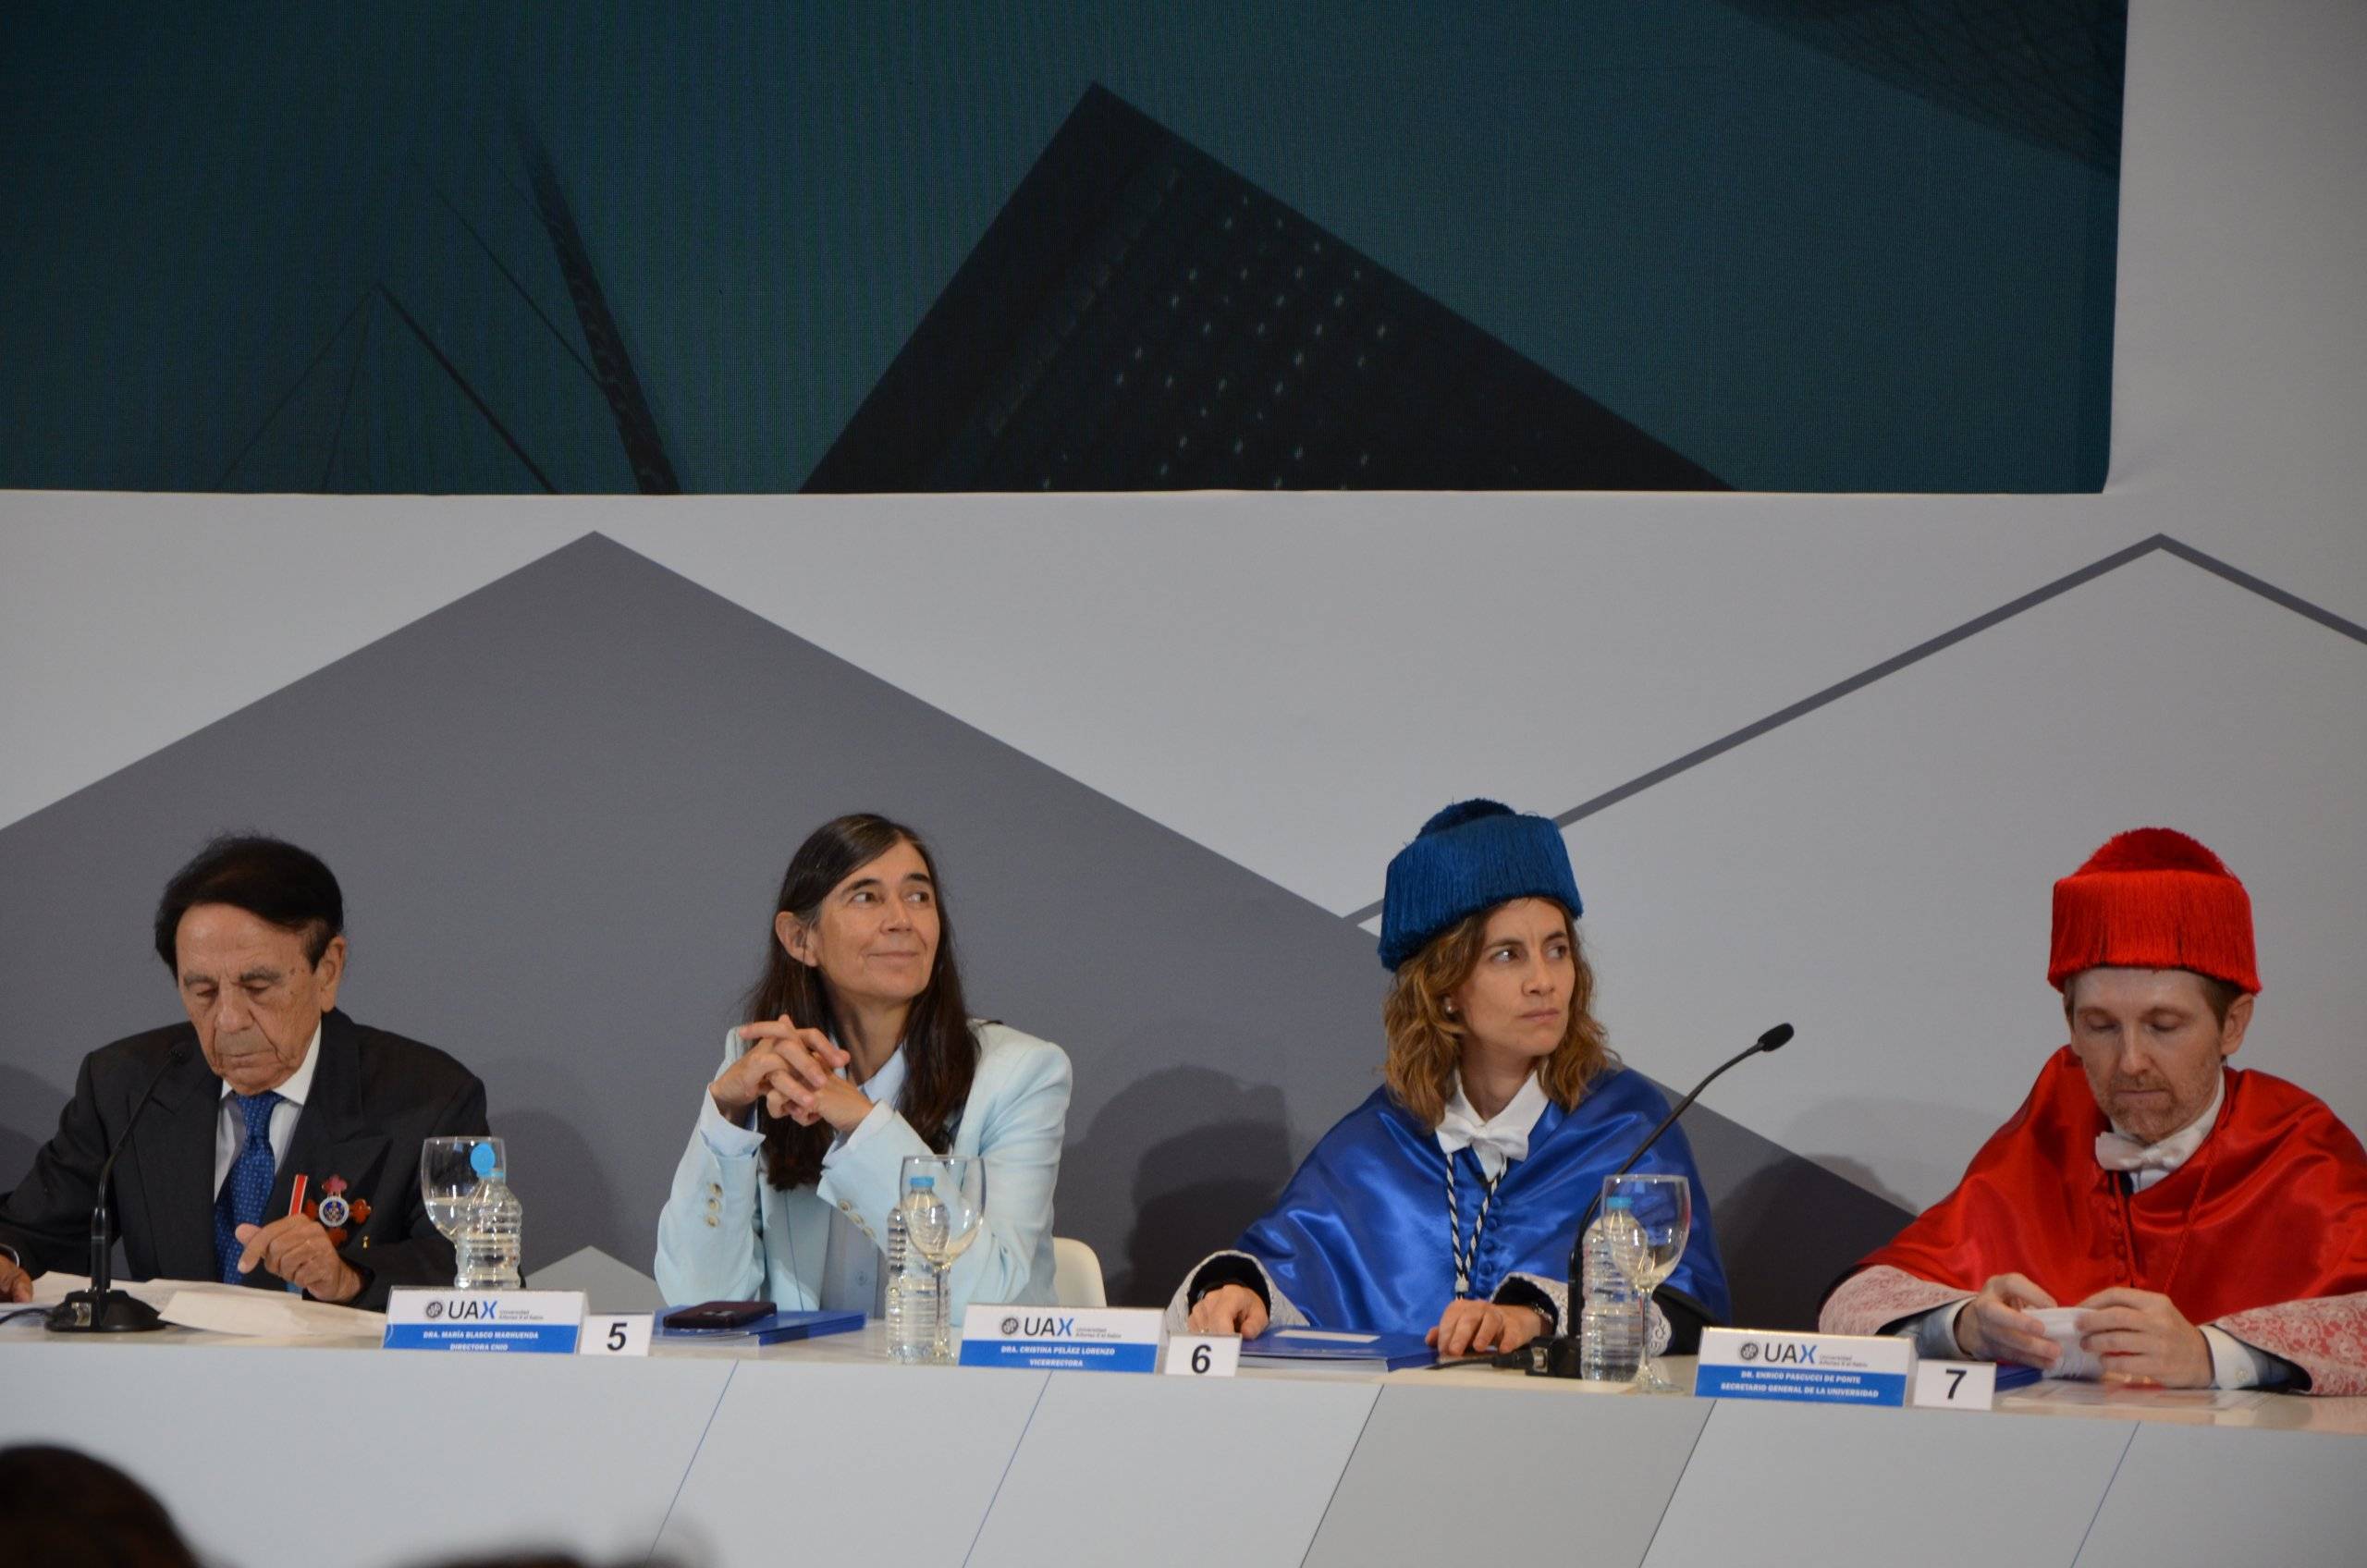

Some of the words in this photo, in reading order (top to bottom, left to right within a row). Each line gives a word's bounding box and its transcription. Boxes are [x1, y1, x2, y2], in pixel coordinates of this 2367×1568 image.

[448, 1300, 498, 1320] UAX
[441, 1329, 464, 1339] MARÍA
[465, 1331, 493, 1340] BLASCO
[494, 1331, 539, 1340] MARHUENDA
[607, 1322, 628, 1351] 5
[1024, 1317, 1074, 1337] UAX
[1000, 1345, 1017, 1354] DRA.
[1020, 1346, 1051, 1354] CRISTINA
[1053, 1345, 1080, 1354] PELÁEZ
[1082, 1347, 1116, 1355] LORENZO
[1191, 1344, 1212, 1374] 6
[1764, 1342, 1818, 1364] UAX
[1029, 1358, 1084, 1366] VICERRECTORA
[1740, 1370, 1754, 1378] DR.
[1755, 1371, 1784, 1379] ENRICO
[1785, 1372, 1822, 1381] PASCUCCI
[1824, 1374, 1835, 1382] DE
[1836, 1375, 1861, 1384] PONTE
[1945, 1368, 1968, 1400] 7
[1721, 1382, 1767, 1391] SECRETARIO
[1768, 1384, 1802, 1393] GENERAL
[1804, 1386, 1815, 1394] DE
[1816, 1387, 1826, 1395] LA
[1827, 1388, 1880, 1398] UNIVERSIDAD
